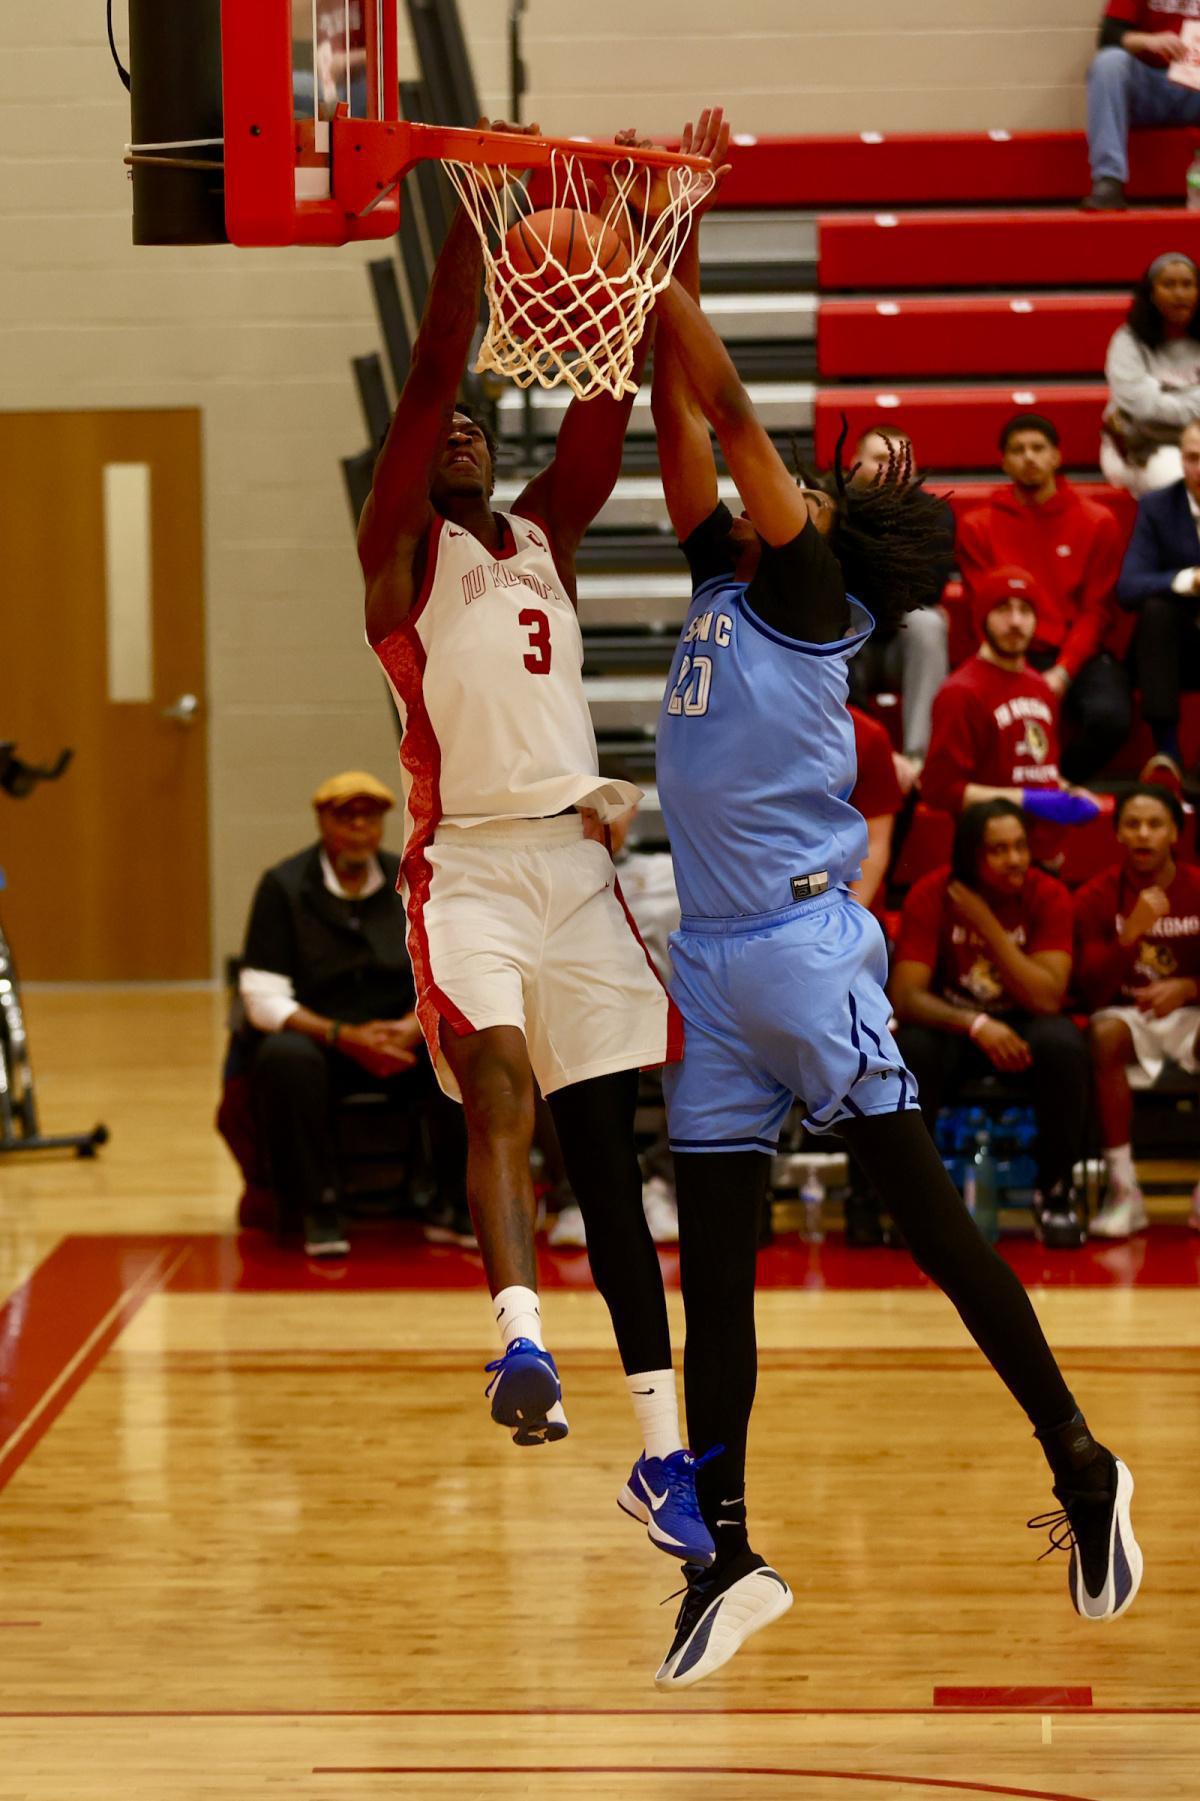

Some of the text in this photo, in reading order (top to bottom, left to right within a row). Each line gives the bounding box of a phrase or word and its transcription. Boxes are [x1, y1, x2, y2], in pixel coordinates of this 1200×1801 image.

[461, 564, 487, 605] IU
[518, 608, 553, 675] 3
[667, 655, 713, 717] 20
